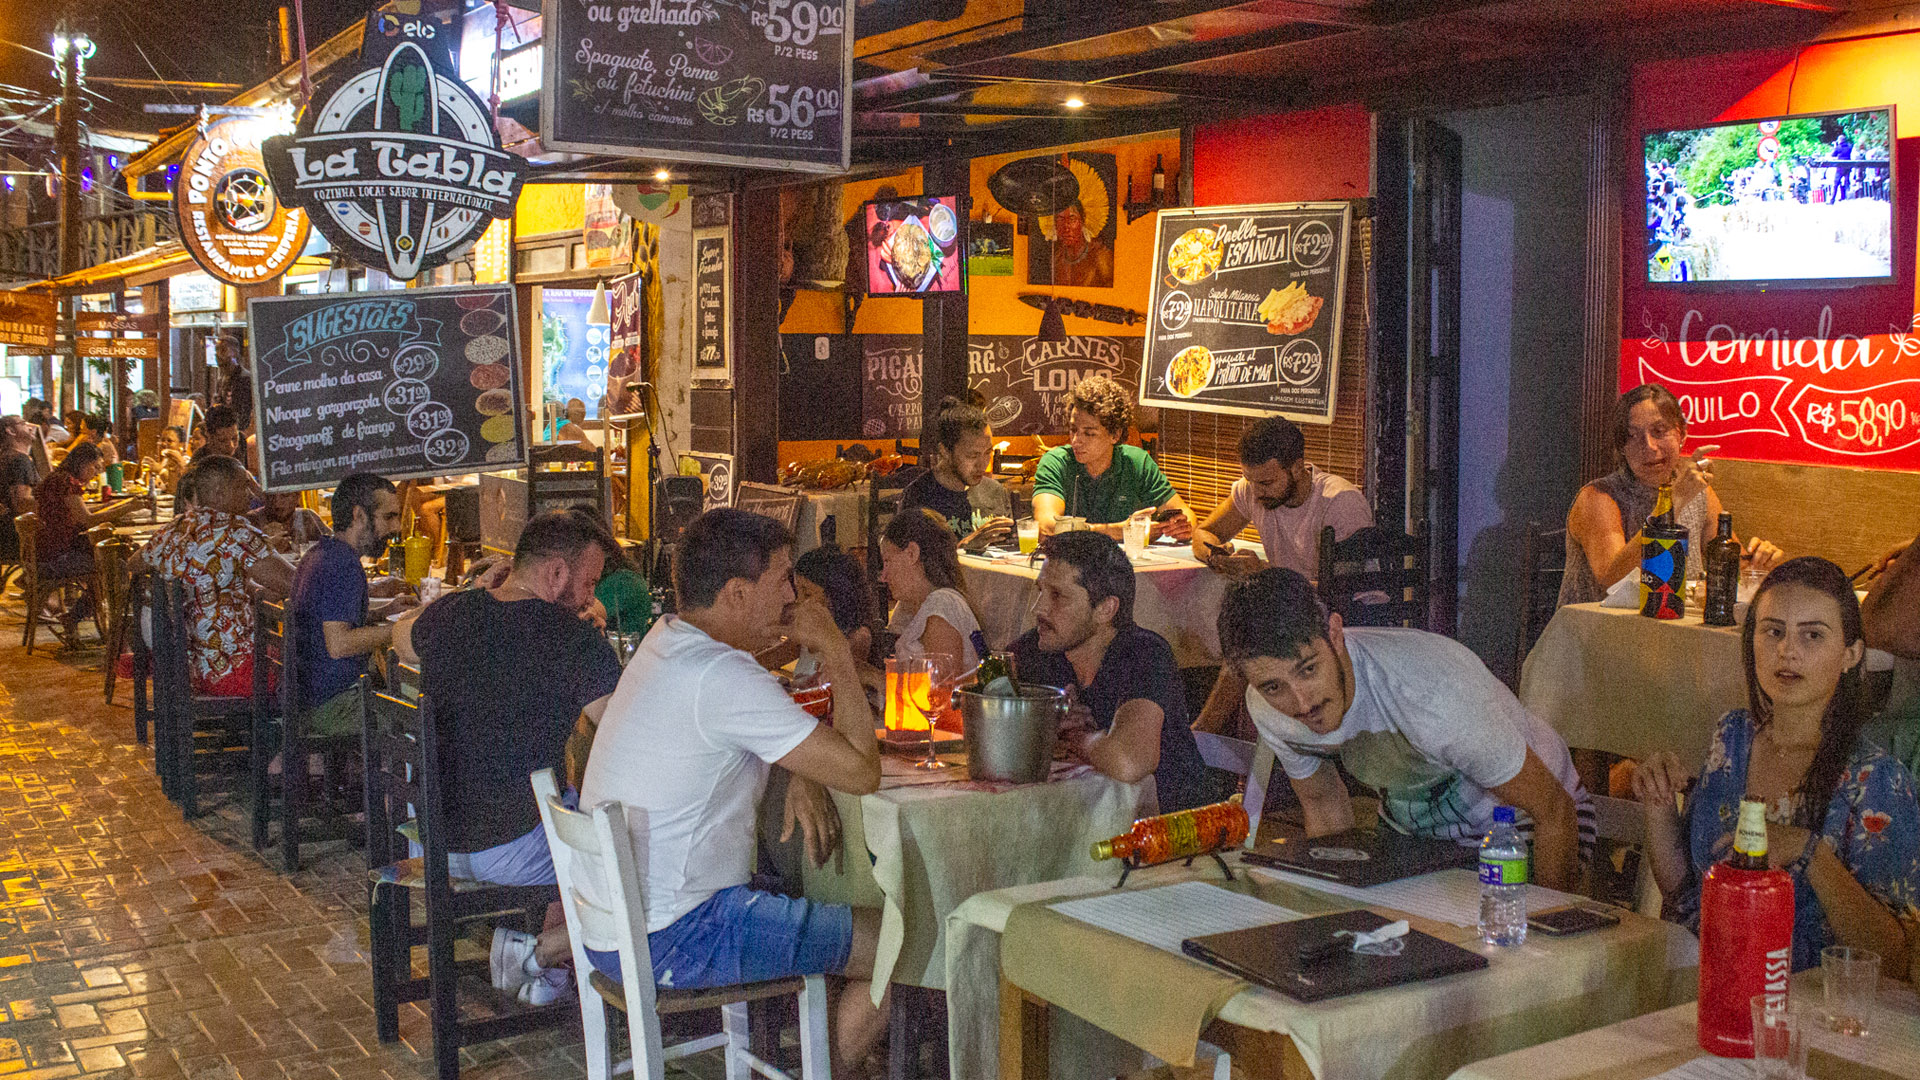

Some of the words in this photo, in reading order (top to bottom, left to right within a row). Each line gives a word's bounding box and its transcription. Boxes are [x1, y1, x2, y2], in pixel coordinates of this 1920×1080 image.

[404, 20, 435, 39] elo
[587, 5, 613, 22] ou
[618, 0, 701, 32] grelhado
[774, 45, 793, 57] P/2
[796, 48, 818, 60] PESS
[666, 54, 719, 82] Penne
[597, 77, 617, 91] ou
[624, 74, 697, 104] fetuchini
[612, 106, 643, 119] molho
[770, 127, 789, 139] P/2
[791, 129, 814, 140] PESS
[188, 138, 229, 204] PONTO
[286, 147, 360, 184] La
[371, 140, 517, 197] Tabla
[314, 188, 356, 200] COZINHA
[359, 186, 386, 198] LOCAL
[389, 187, 418, 198] SABOR
[422, 189, 493, 210] INTERNACIONAL
[192, 211, 254, 279] RESTAURANTE
[255, 265, 267, 276] &
[1213, 218, 1258, 249] Paella
[1225, 233, 1286, 268] ESPAÑOLA
[1193, 299, 1259, 321] NAPOLITANA
[98, 321, 138, 330] MASSAS
[293, 301, 414, 350] SUGESTÕES
[1679, 305, 1884, 374] Comida
[88, 346, 147, 355] GRELHADOS
[1025, 335, 1121, 368] CARNES
[264, 380, 302, 398] Penne
[303, 372, 338, 390] molho
[340, 370, 355, 385] da
[1252, 363, 1273, 382] MAR
[266, 406, 312, 425] Nhoque
[317, 393, 381, 420] gorgonzola
[1678, 391, 1761, 424] QUILO
[268, 425, 333, 451] Strogonoff
[342, 423, 356, 438] de
[357, 421, 395, 440] frango
